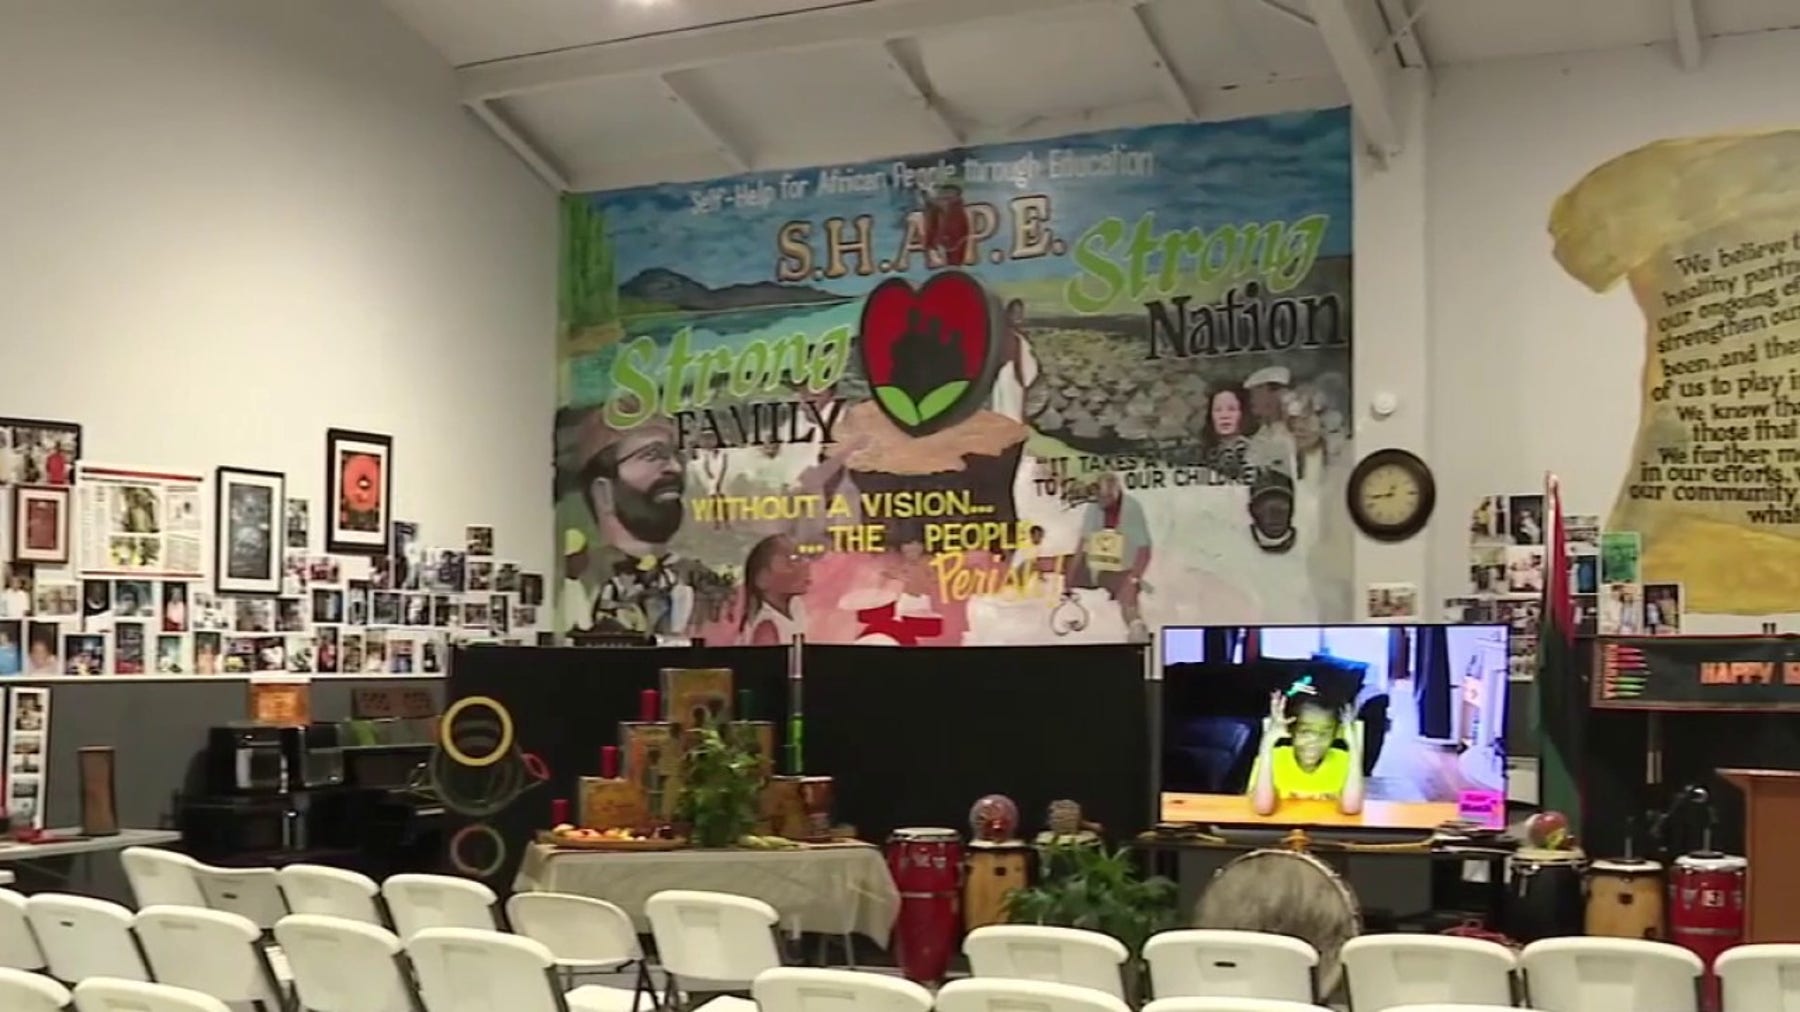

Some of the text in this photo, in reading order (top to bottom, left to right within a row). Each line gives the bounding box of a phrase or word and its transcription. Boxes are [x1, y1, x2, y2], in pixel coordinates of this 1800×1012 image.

[779, 172, 809, 199] for
[816, 166, 887, 196] African
[892, 157, 957, 195] People
[963, 149, 1042, 188] through
[1048, 143, 1155, 178] Education
[777, 195, 1067, 282] S.H.AP.E.
[1063, 211, 1331, 314] Strong
[1674, 253, 1711, 276] We
[1718, 241, 1786, 268] believe
[1661, 275, 1738, 308] healthy
[1143, 281, 1348, 361] Nation
[1656, 310, 1693, 333] our
[1699, 287, 1778, 319] ongoing
[1656, 315, 1768, 354] strengthen
[603, 325, 851, 430] Strong
[1652, 378, 1674, 402] of
[1680, 382, 1705, 397] us
[1711, 375, 1732, 396] to
[1737, 370, 1784, 399] play
[676, 398, 846, 449] FAMILY
[1676, 405, 1704, 421] We
[1711, 403, 1770, 420] know
[1693, 418, 1798, 442] those that
[1078, 453, 1138, 473] TAKES
[1658, 447, 1687, 464] We
[1693, 442, 1770, 464] further
[1034, 477, 1057, 497] TO
[1124, 470, 1166, 490] OUR
[1641, 461, 1663, 482] in
[1667, 466, 1707, 481] our
[690, 494, 822, 522] WITHOUT
[827, 494, 851, 518] A
[1629, 484, 1798, 507] our community
[924, 519, 1036, 552] PEOPLE
[1700, 661, 1774, 684] HAPPY
